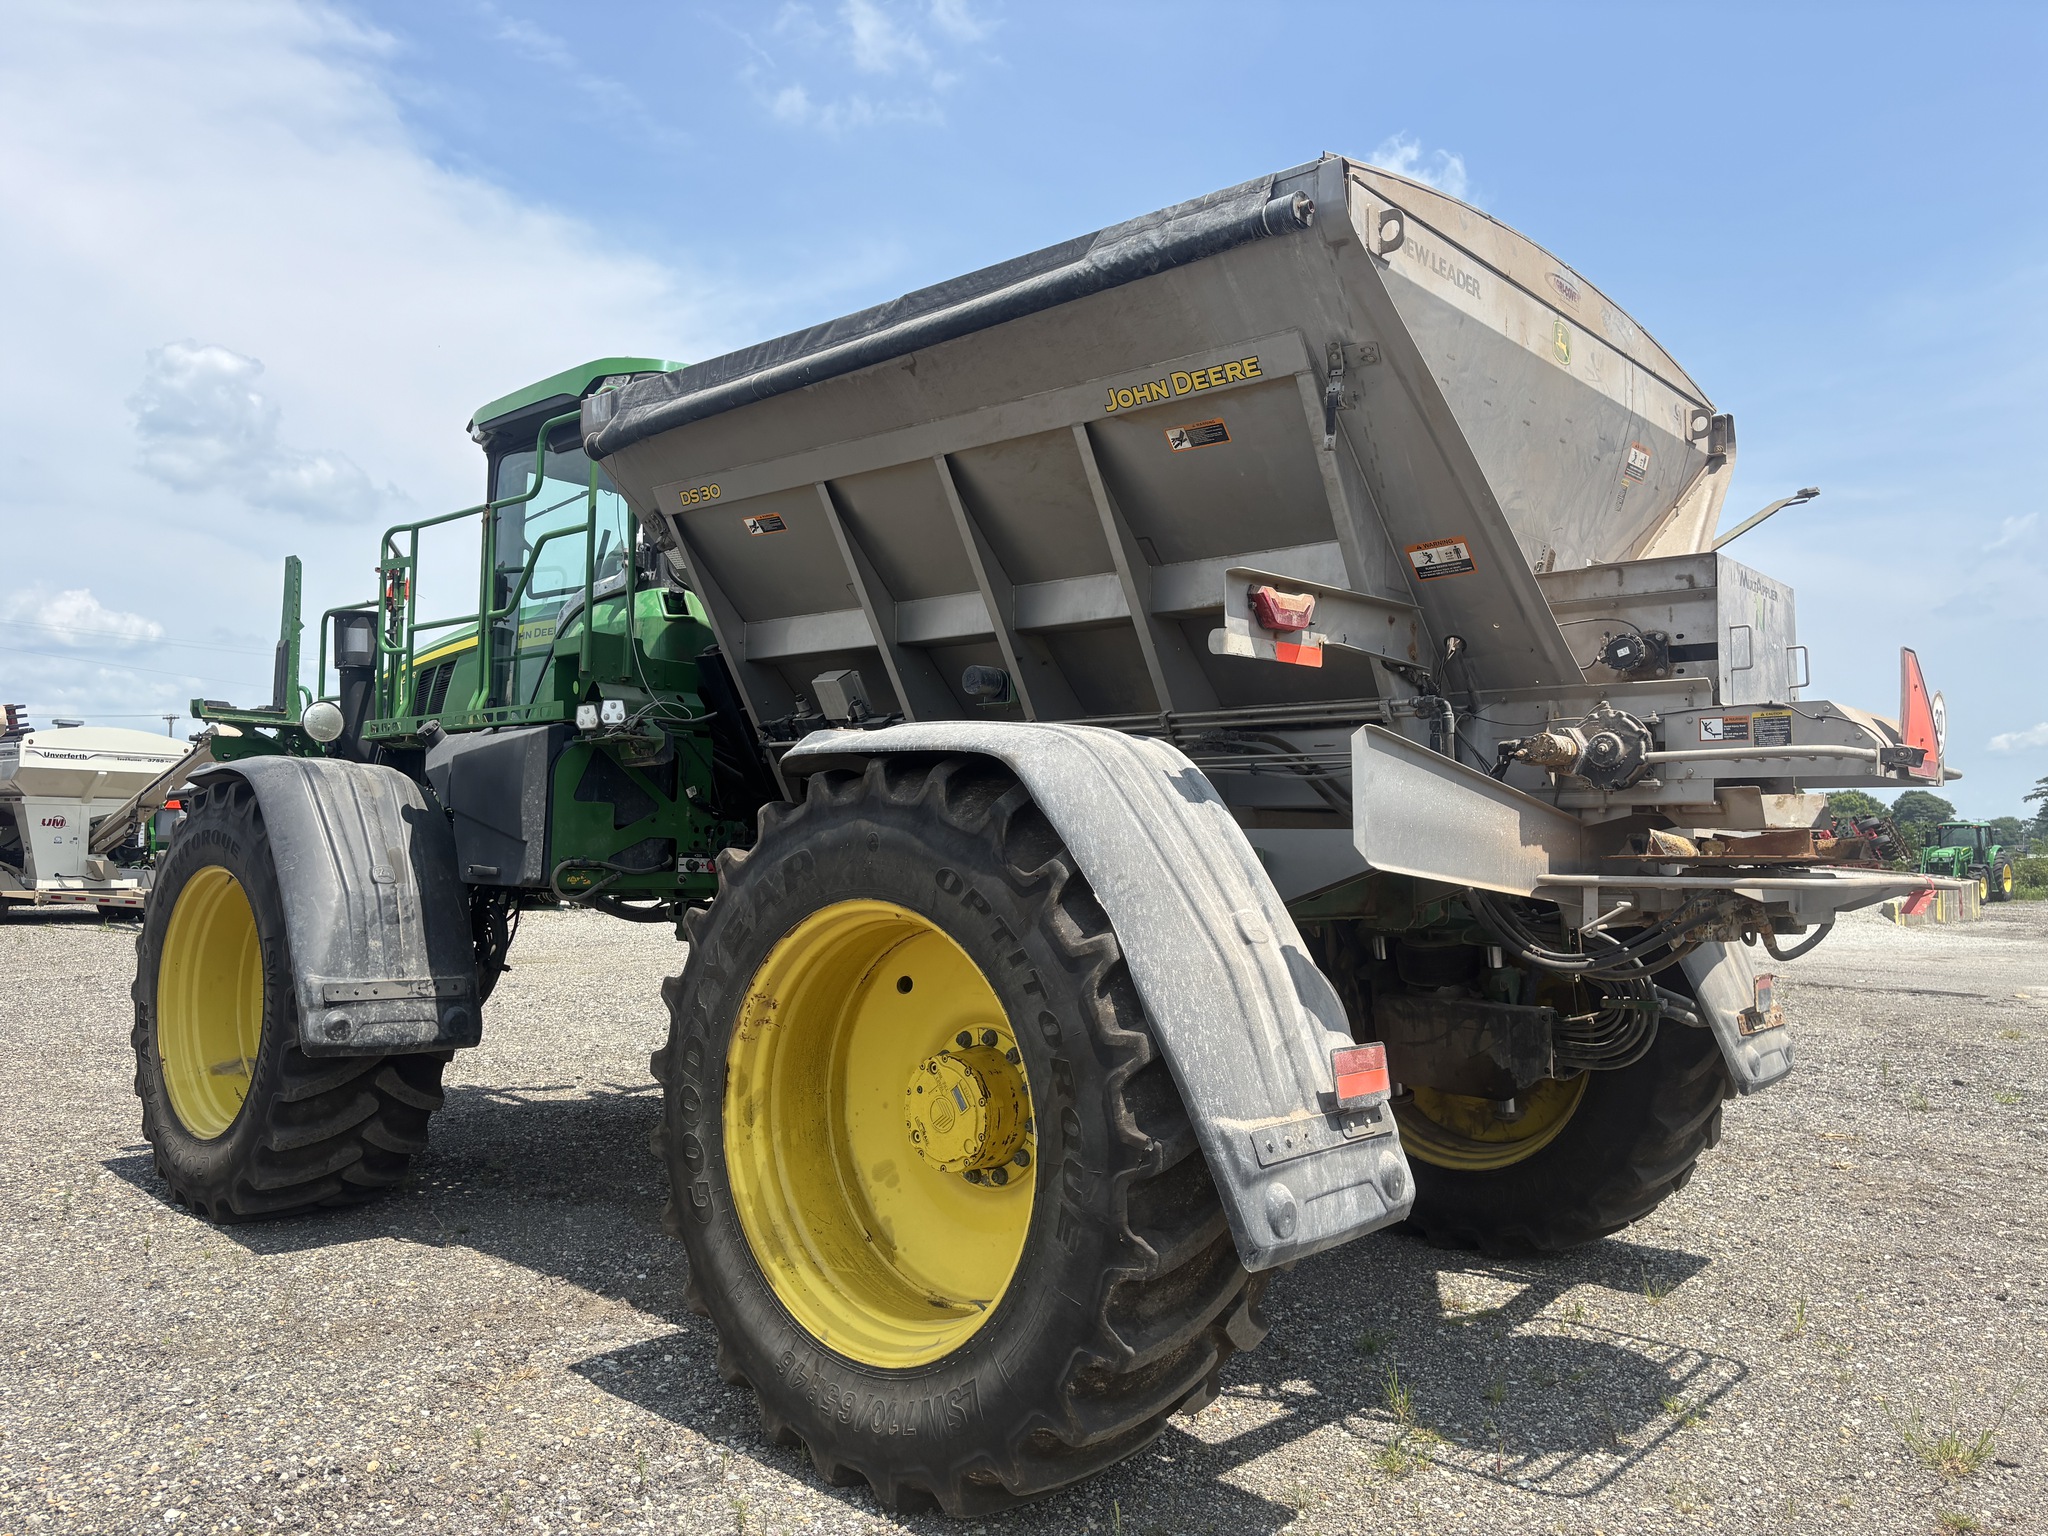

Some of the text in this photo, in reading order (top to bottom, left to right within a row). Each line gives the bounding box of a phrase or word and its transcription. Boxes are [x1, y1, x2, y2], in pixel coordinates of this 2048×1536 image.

[1431, 252, 1481, 300] LEADER
[1105, 355, 1263, 412] JOHN DEERE
[1423, 538, 1454, 549] WARNING
[43, 751, 88, 760] Unverferth
[681, 848, 818, 1225] GOODYEAR
[935, 867, 1087, 1256] OPTITORQUE
